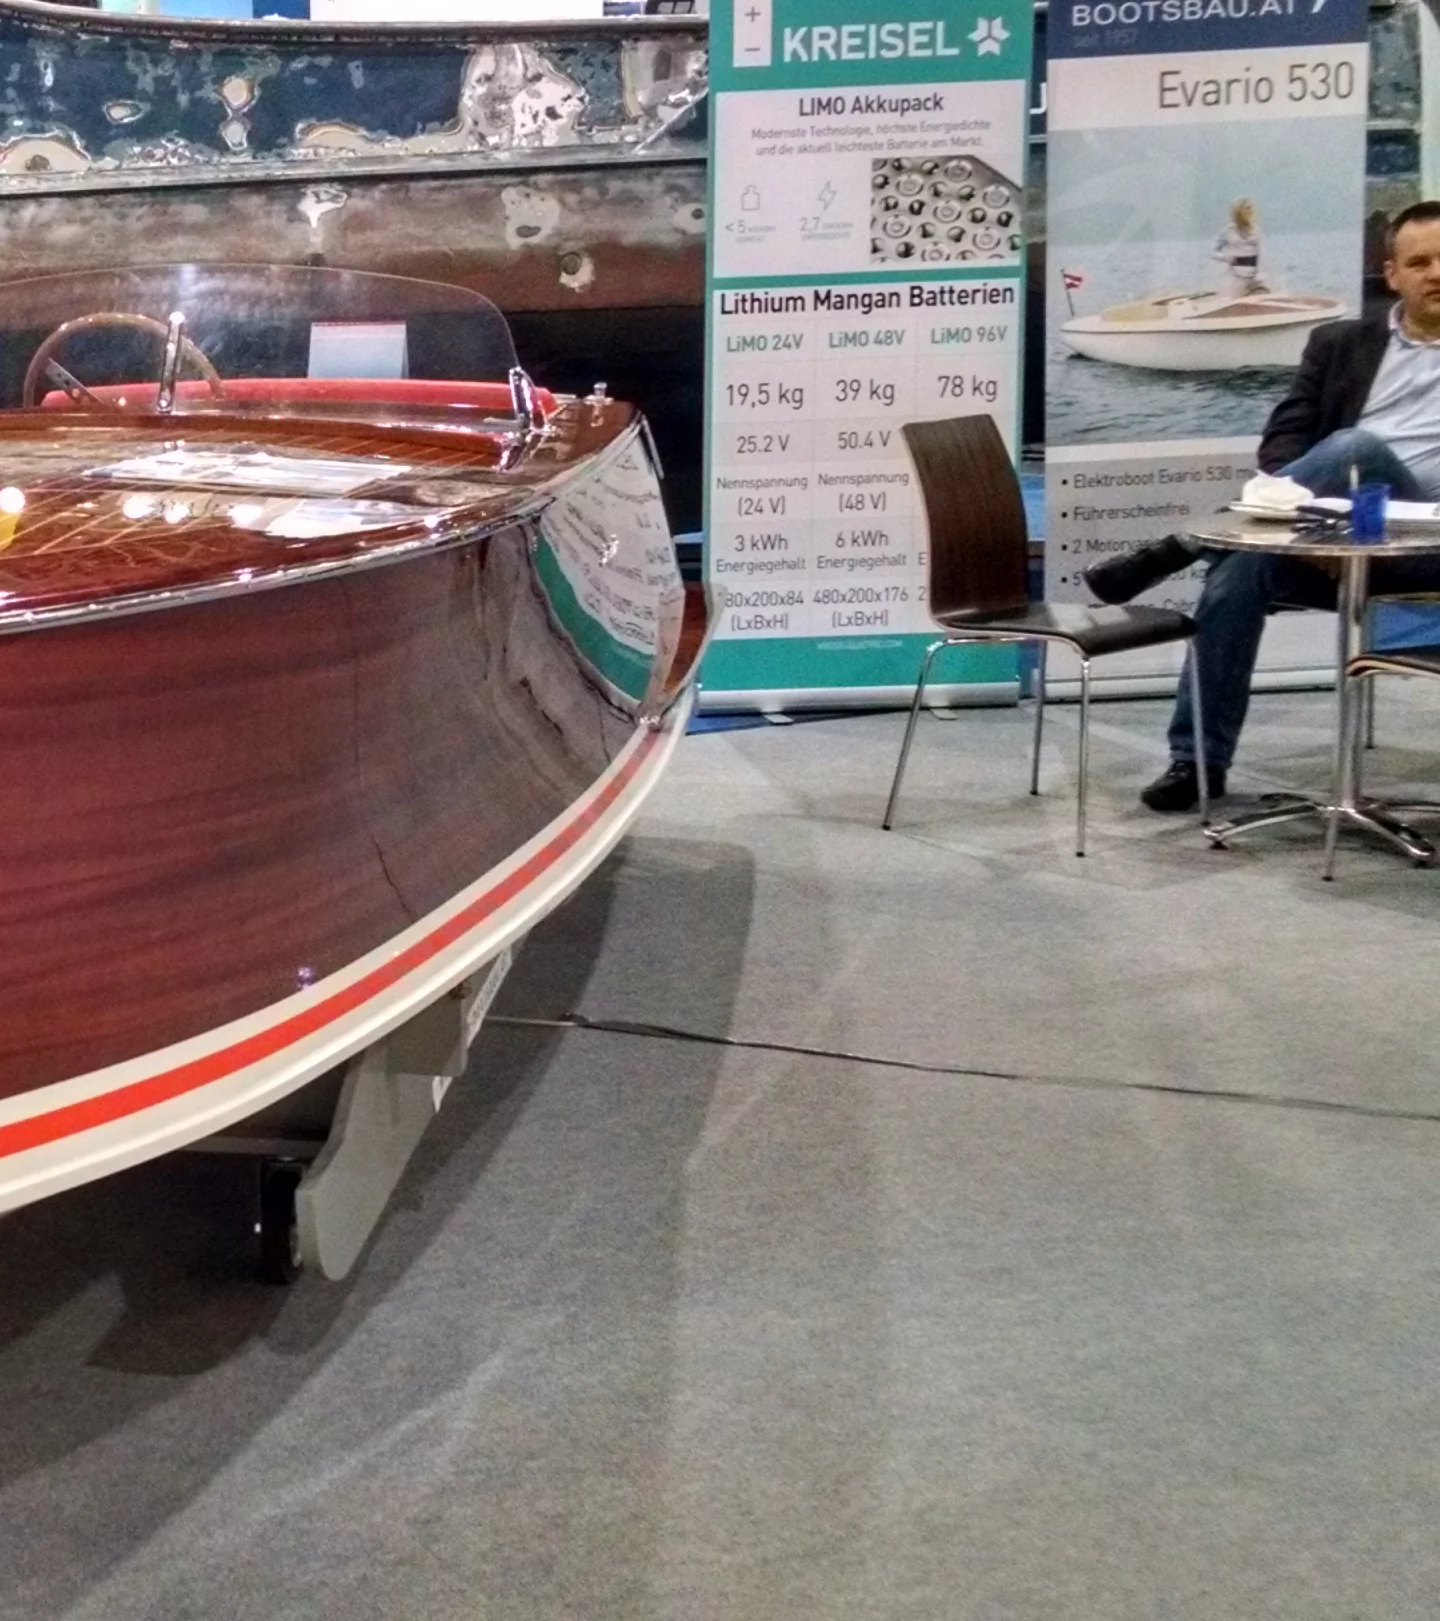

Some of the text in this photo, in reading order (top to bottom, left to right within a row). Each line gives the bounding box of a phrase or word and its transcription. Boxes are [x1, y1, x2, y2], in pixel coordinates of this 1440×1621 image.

[782, 21, 960, 63] KREISEL
[1159, 61, 1355, 109] Evario 530
[798, 93, 944, 117] LIMO Akkupack
[751, 119, 991, 140] Modernste Technologie, höchste Energiedichte
[756, 143, 777, 156] und
[779, 142, 795, 155] die
[796, 141, 832, 155] aktuell
[834, 139, 885, 154] leichteste
[887, 136, 929, 150] Batterie
[930, 138, 948, 148] am
[737, 219, 747, 235] 5
[720, 285, 1015, 315] Lithium Mangan Batterien
[727, 333, 804, 352] LiMO 24V
[828, 329, 906, 348] LiMO 48V
[931, 325, 1008, 344] LiMO 96V
[726, 382, 804, 410] 19,5 kg
[835, 379, 896, 407] 39 kg
[937, 375, 998, 402] 78 kg
[736, 434, 790, 454] 25.2 V
[838, 430, 891, 450] 50.4 V
[716, 476, 808, 491] Nennspannung
[818, 472, 910, 488] Nennspannung
[1073, 472, 1154, 489] Elektroboot
[1158, 468, 1202, 485] Evario
[1205, 465, 1233, 481] 530
[1073, 503, 1190, 522] Führerscheinfrei
[734, 533, 788, 552] 3 kWh
[835, 529, 889, 548] 6 kWh
[1072, 539, 1082, 554] 2
[716, 558, 806, 575] Energiegehalt
[817, 554, 907, 571] Energiegehalt
[719, 590, 804, 608] 80x200x84
[812, 587, 909, 604] 480x200x176
[731, 613, 789, 632] (LxBxH)
[832, 609, 889, 628] (LxBxH)
